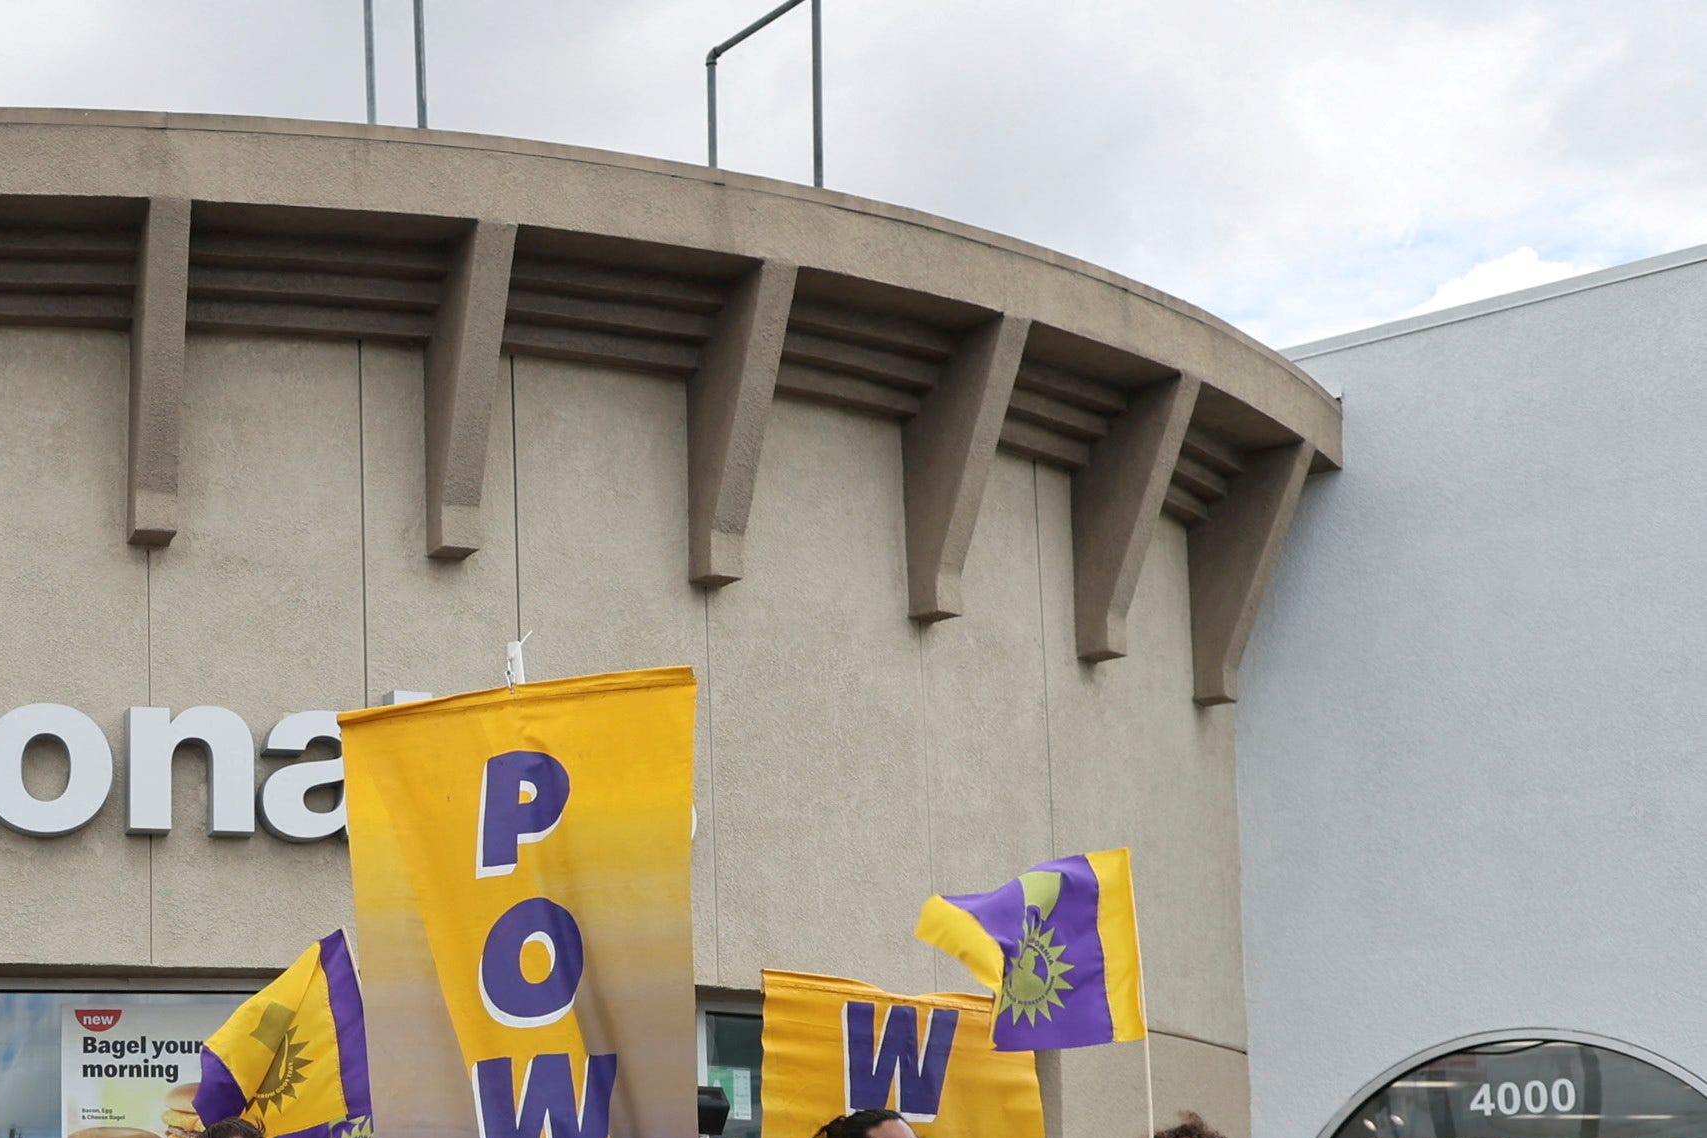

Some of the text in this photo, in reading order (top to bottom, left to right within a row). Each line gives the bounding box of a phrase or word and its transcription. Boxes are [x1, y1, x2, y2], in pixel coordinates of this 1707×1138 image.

[83, 1015, 114, 1025] new
[82, 1036, 203, 1059] Bagel your
[82, 1059, 179, 1083] morning
[1470, 1078, 1576, 1116] 4000
